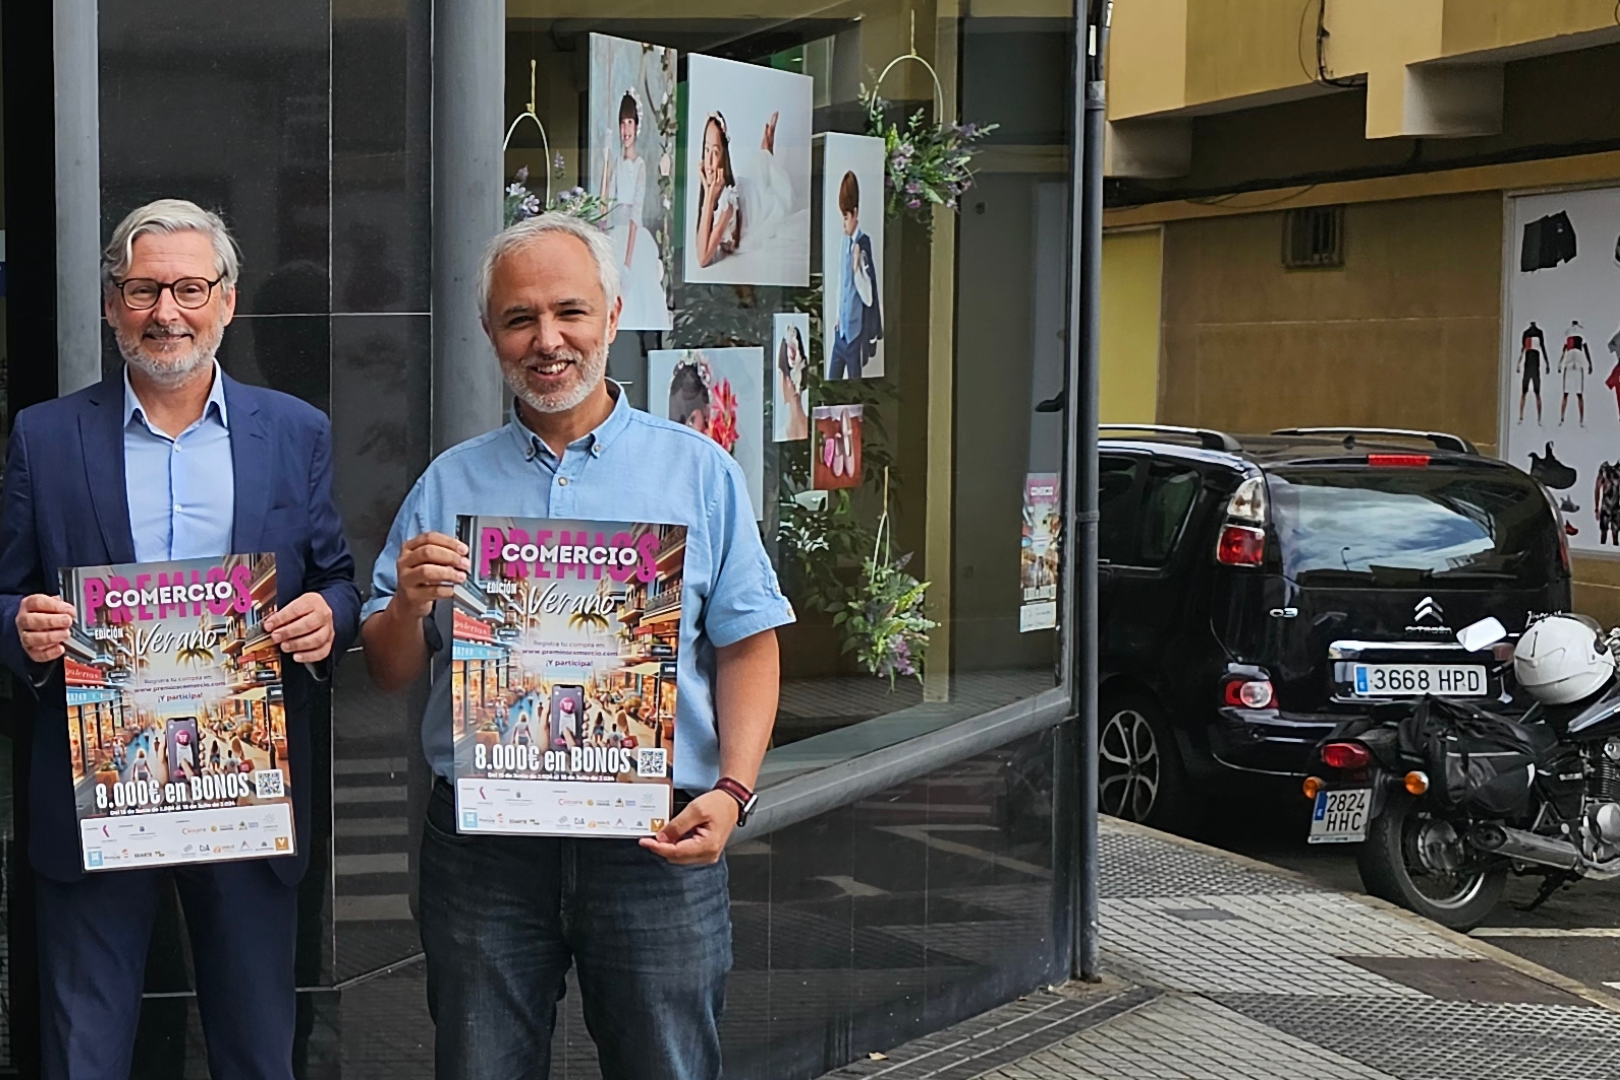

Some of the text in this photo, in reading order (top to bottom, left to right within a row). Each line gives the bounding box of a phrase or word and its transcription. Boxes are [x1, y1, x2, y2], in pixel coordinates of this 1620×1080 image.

[480, 526, 660, 583] PREMIOS
[501, 543, 638, 567] COMERCIO
[84, 564, 253, 626] PREMIOS
[105, 581, 233, 608] COMERCIO
[486, 579, 518, 595] EDICIÓN
[528, 581, 616, 616] Verano
[94, 625, 124, 640] EDICIÓN
[136, 622, 218, 656] Verano
[1373, 669, 1480, 691] 3668 HPD
[475, 743, 631, 774] 8.000€ en BONOS
[95, 773, 250, 809] 8.000€ en BONOS
[1326, 792, 1365, 813] 2824
[1326, 812, 1362, 832] HHC
